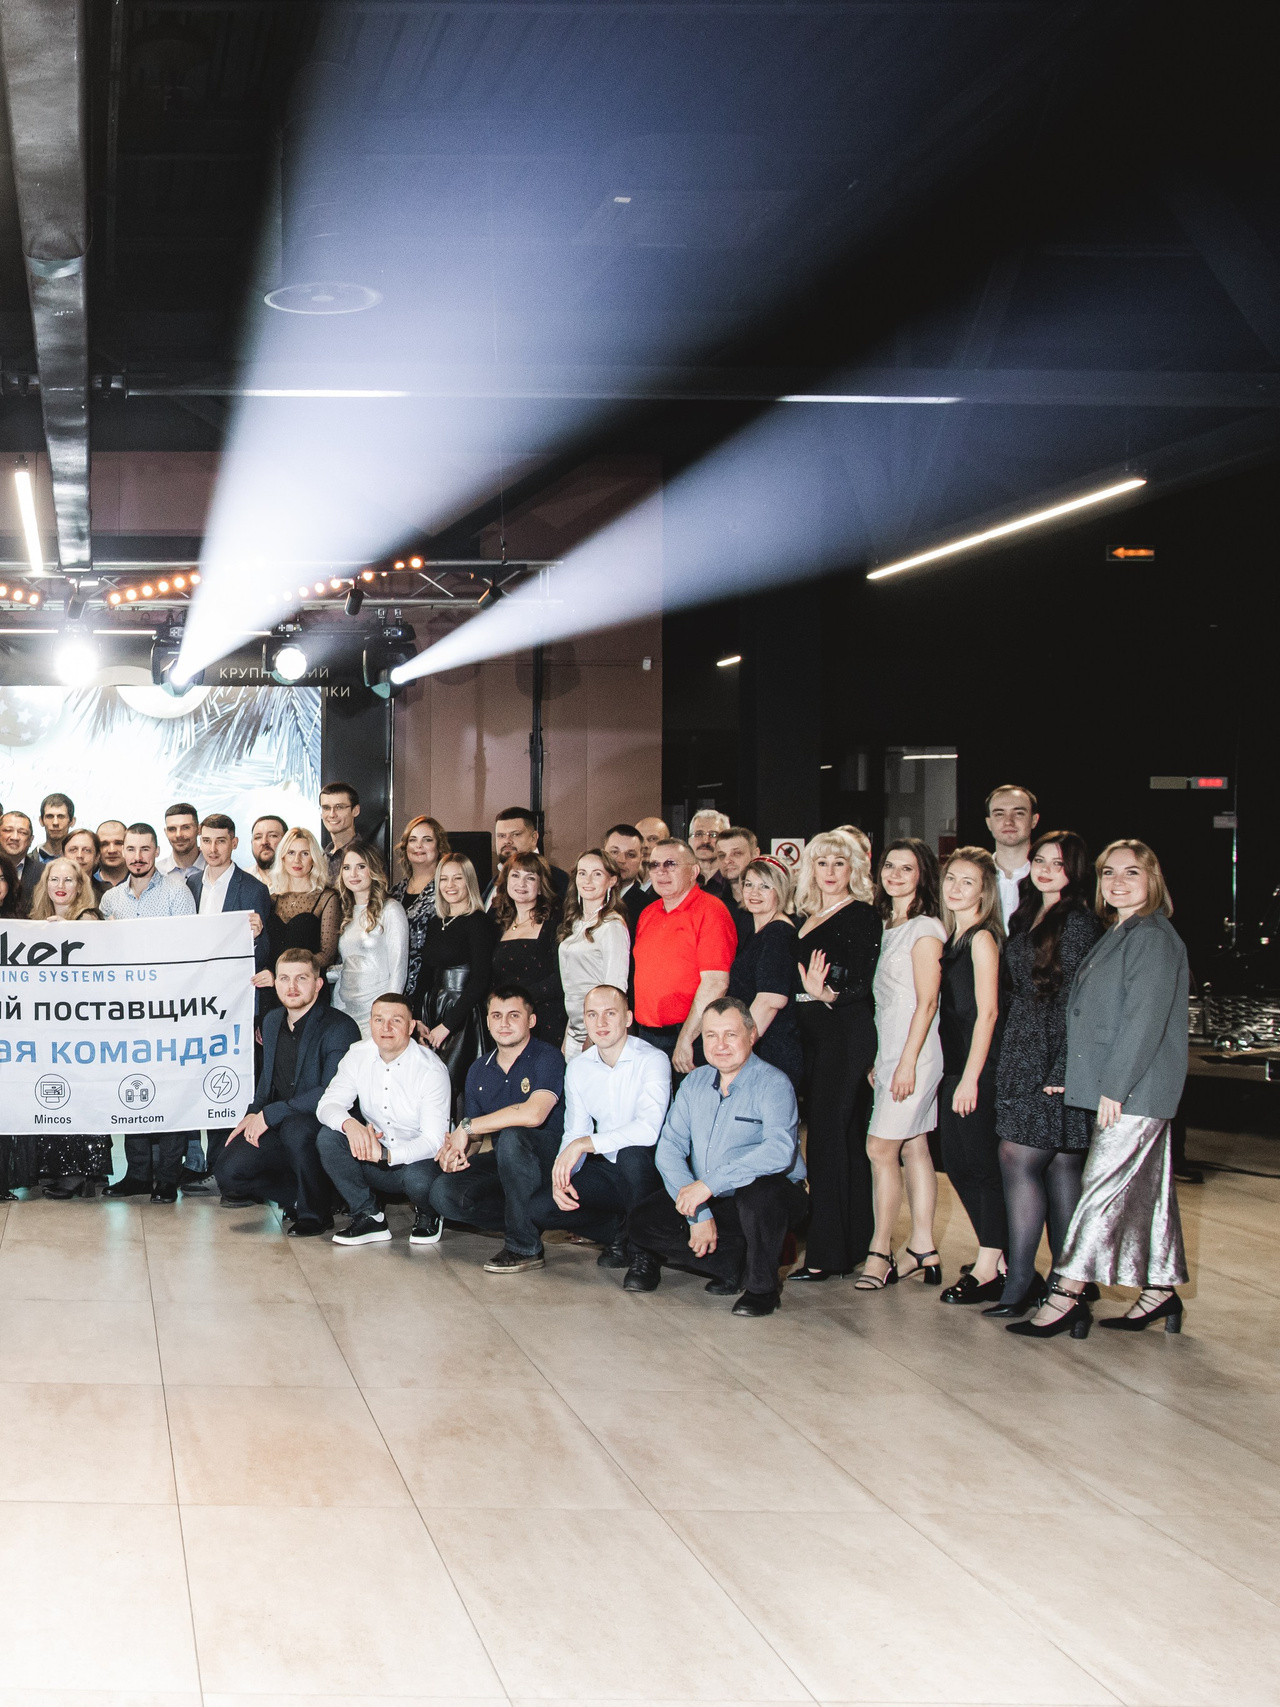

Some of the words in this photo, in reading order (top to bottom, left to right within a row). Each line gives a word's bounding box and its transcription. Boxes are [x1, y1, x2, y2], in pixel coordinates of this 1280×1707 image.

[38, 970, 116, 983] SYSTEMS
[125, 969, 158, 982] RUS
[34, 995, 227, 1022] поставщик,
[51, 1024, 241, 1067] команда!
[34, 1113, 72, 1125] Mincos
[110, 1113, 165, 1125] Smartcom
[207, 1107, 236, 1119] Endis
